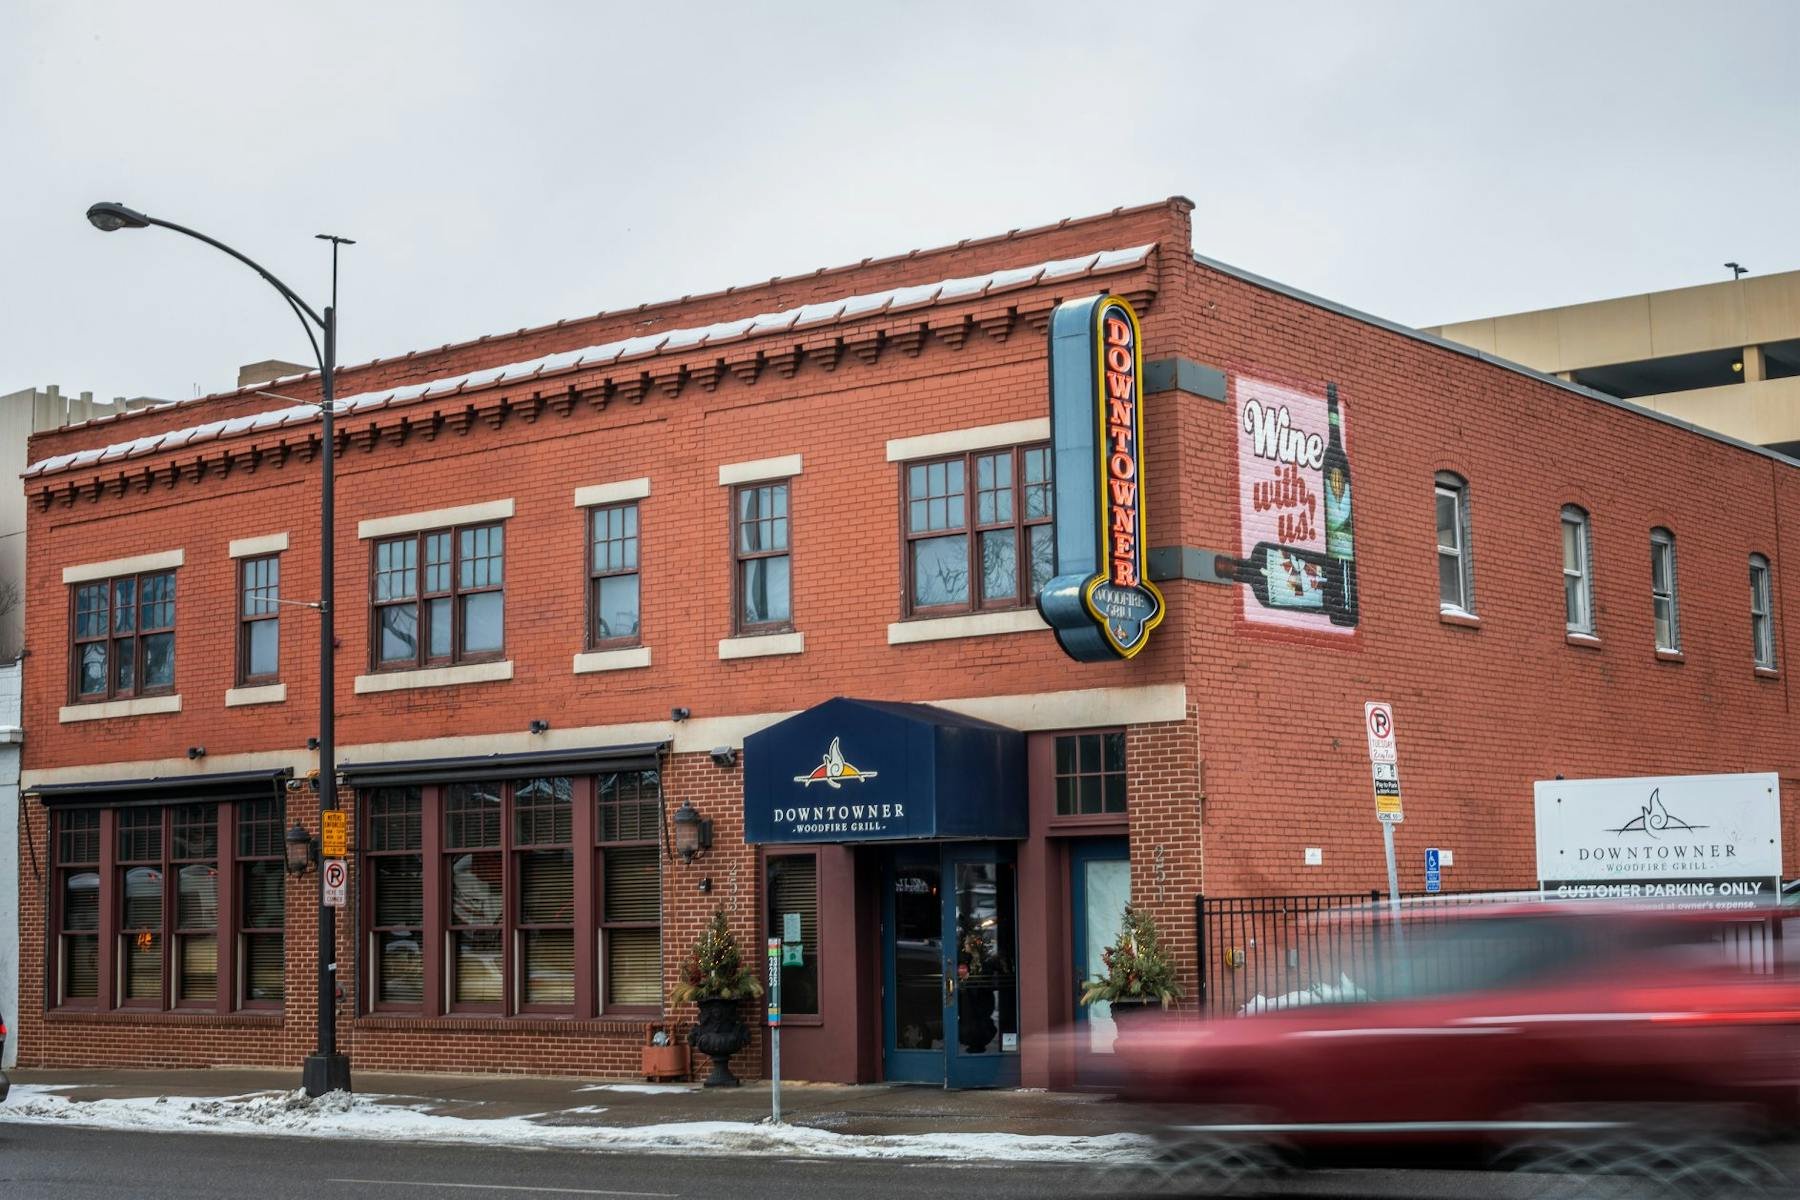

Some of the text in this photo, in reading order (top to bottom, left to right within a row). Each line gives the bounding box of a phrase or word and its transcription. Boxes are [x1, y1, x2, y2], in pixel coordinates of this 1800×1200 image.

[1106, 318, 1138, 587] DOWNTOWNER
[1243, 398, 1324, 471] Wine
[1253, 464, 1310, 512] with
[1278, 493, 1316, 544] us!
[1094, 588, 1145, 608] WOODFIRE
[774, 803, 904, 822] DOWNTOWNER
[1154, 844, 1166, 902] 251
[1579, 844, 1737, 861] DOWNTOWNER
[729, 859, 738, 911] 253
[1557, 882, 1763, 898] CUSTOMER PARKING ONLY
[1678, 901, 1714, 910] owner's
[1716, 900, 1757, 911] expense.
